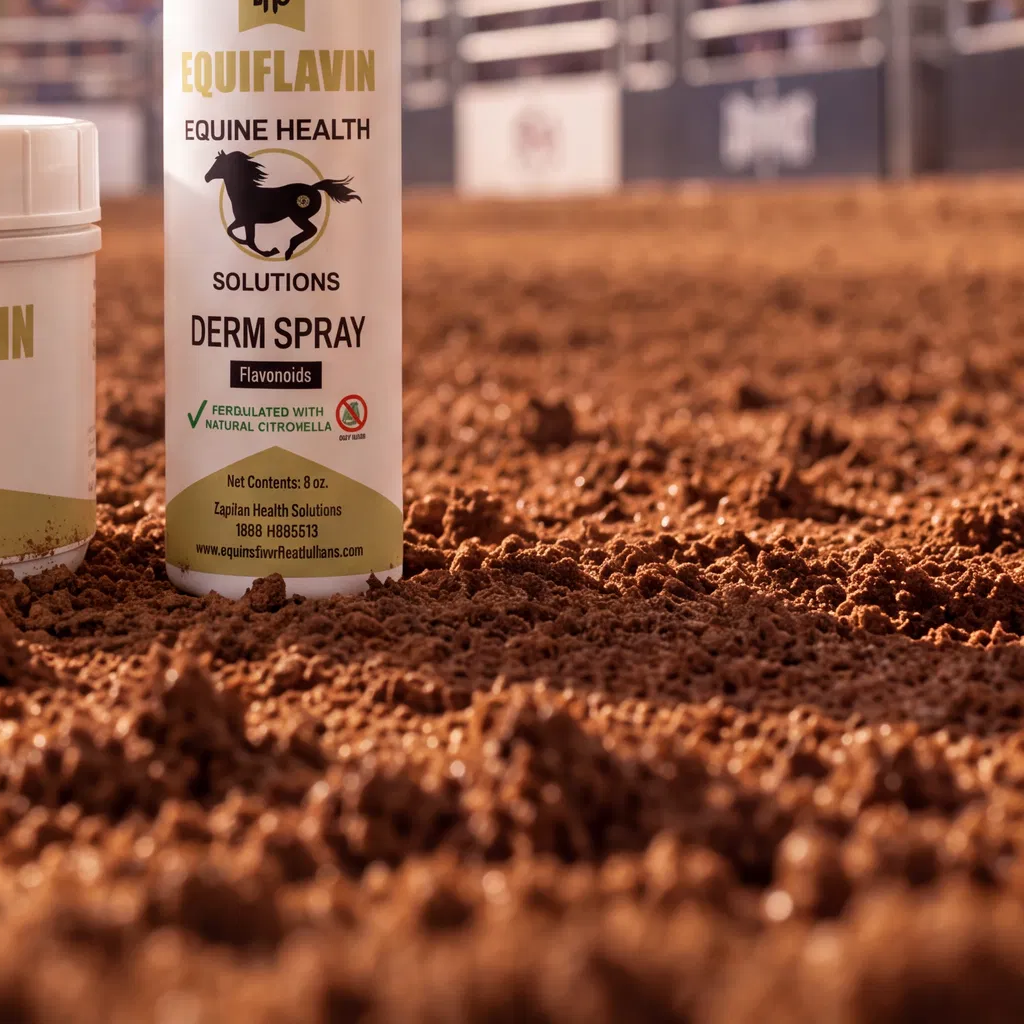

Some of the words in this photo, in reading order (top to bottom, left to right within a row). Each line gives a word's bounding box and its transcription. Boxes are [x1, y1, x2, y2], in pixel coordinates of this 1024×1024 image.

[181, 49, 376, 98] EQUIFLAVIN
[185, 119, 268, 141] EQUINE
[276, 118, 370, 140] HEALTH
[212, 272, 340, 292] SOLUTIONS
[191, 315, 266, 349] DERM
[273, 316, 366, 350] SPRAY
[239, 367, 312, 384] Flavonoids
[293, 407, 324, 417] WITH
[205, 419, 254, 432] NATURAL
[227, 475, 245, 489] Net
[247, 476, 301, 489] Contents:
[303, 476, 311, 489] 8
[313, 478, 329, 489] oz.
[253, 503, 289, 517] Health
[291, 503, 342, 517] Solutions
[236, 523, 262, 537] 1888
